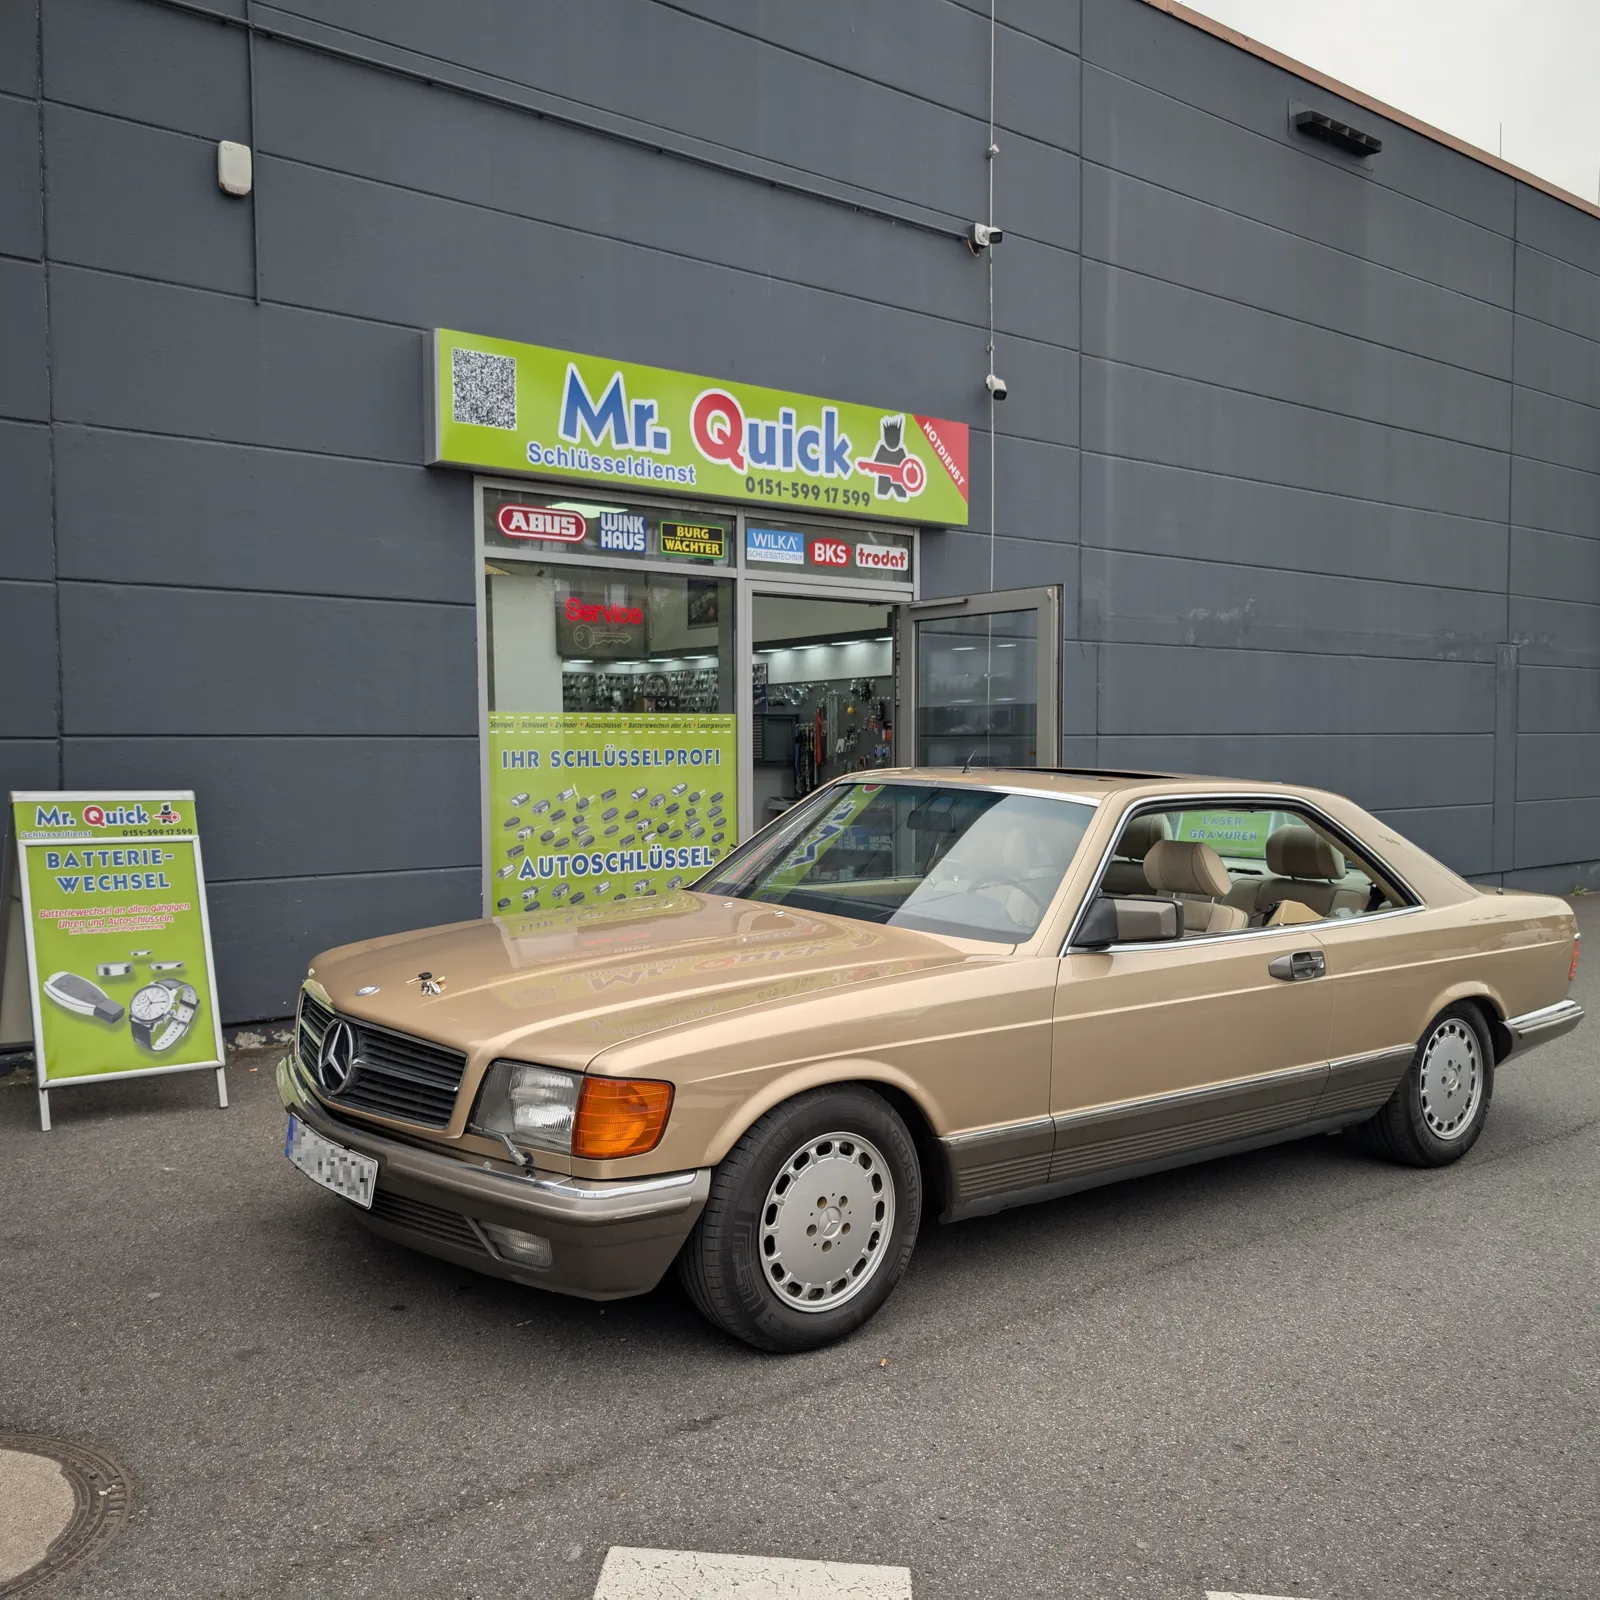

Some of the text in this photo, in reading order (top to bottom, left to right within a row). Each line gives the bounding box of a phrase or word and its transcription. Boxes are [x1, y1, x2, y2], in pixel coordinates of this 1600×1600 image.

[560, 364, 852, 473] Mr. Quick
[527, 442, 695, 484] Schlüsseldienst
[922, 420, 965, 487] NOTDIENST
[745, 475, 871, 508] 0151-599 17 599
[508, 511, 576, 536] ABUS
[601, 513, 644, 533] WINK
[677, 525, 709, 539] BURG
[601, 530, 645, 550] HAUS
[665, 537, 719, 555] WÄCHTER
[748, 551, 803, 561] SCHLIESSTECHNIK
[814, 543, 847, 564] BKS
[858, 548, 905, 568] trodat
[565, 598, 642, 625] Service
[555, 721, 578, 729] Zylinder
[502, 745, 721, 769] IHR SCHLÜSSELPROFI
[36, 804, 149, 827] Mr. Quick
[122, 829, 164, 837] 0151-599
[1189, 829, 1258, 841] GRAVUREN
[47, 849, 174, 868] BATTERIE-
[519, 845, 713, 880] AUTOSCHLÜSSEL
[57, 872, 170, 894] WECHSEL
[39, 907, 112, 918] Batteriewechsel
[114, 907, 125, 915] an
[128, 905, 148, 913] allen
[58, 919, 85, 929] Uhren
[88, 919, 104, 927] und
[886, 1120, 917, 1227] VREDESTEIN
